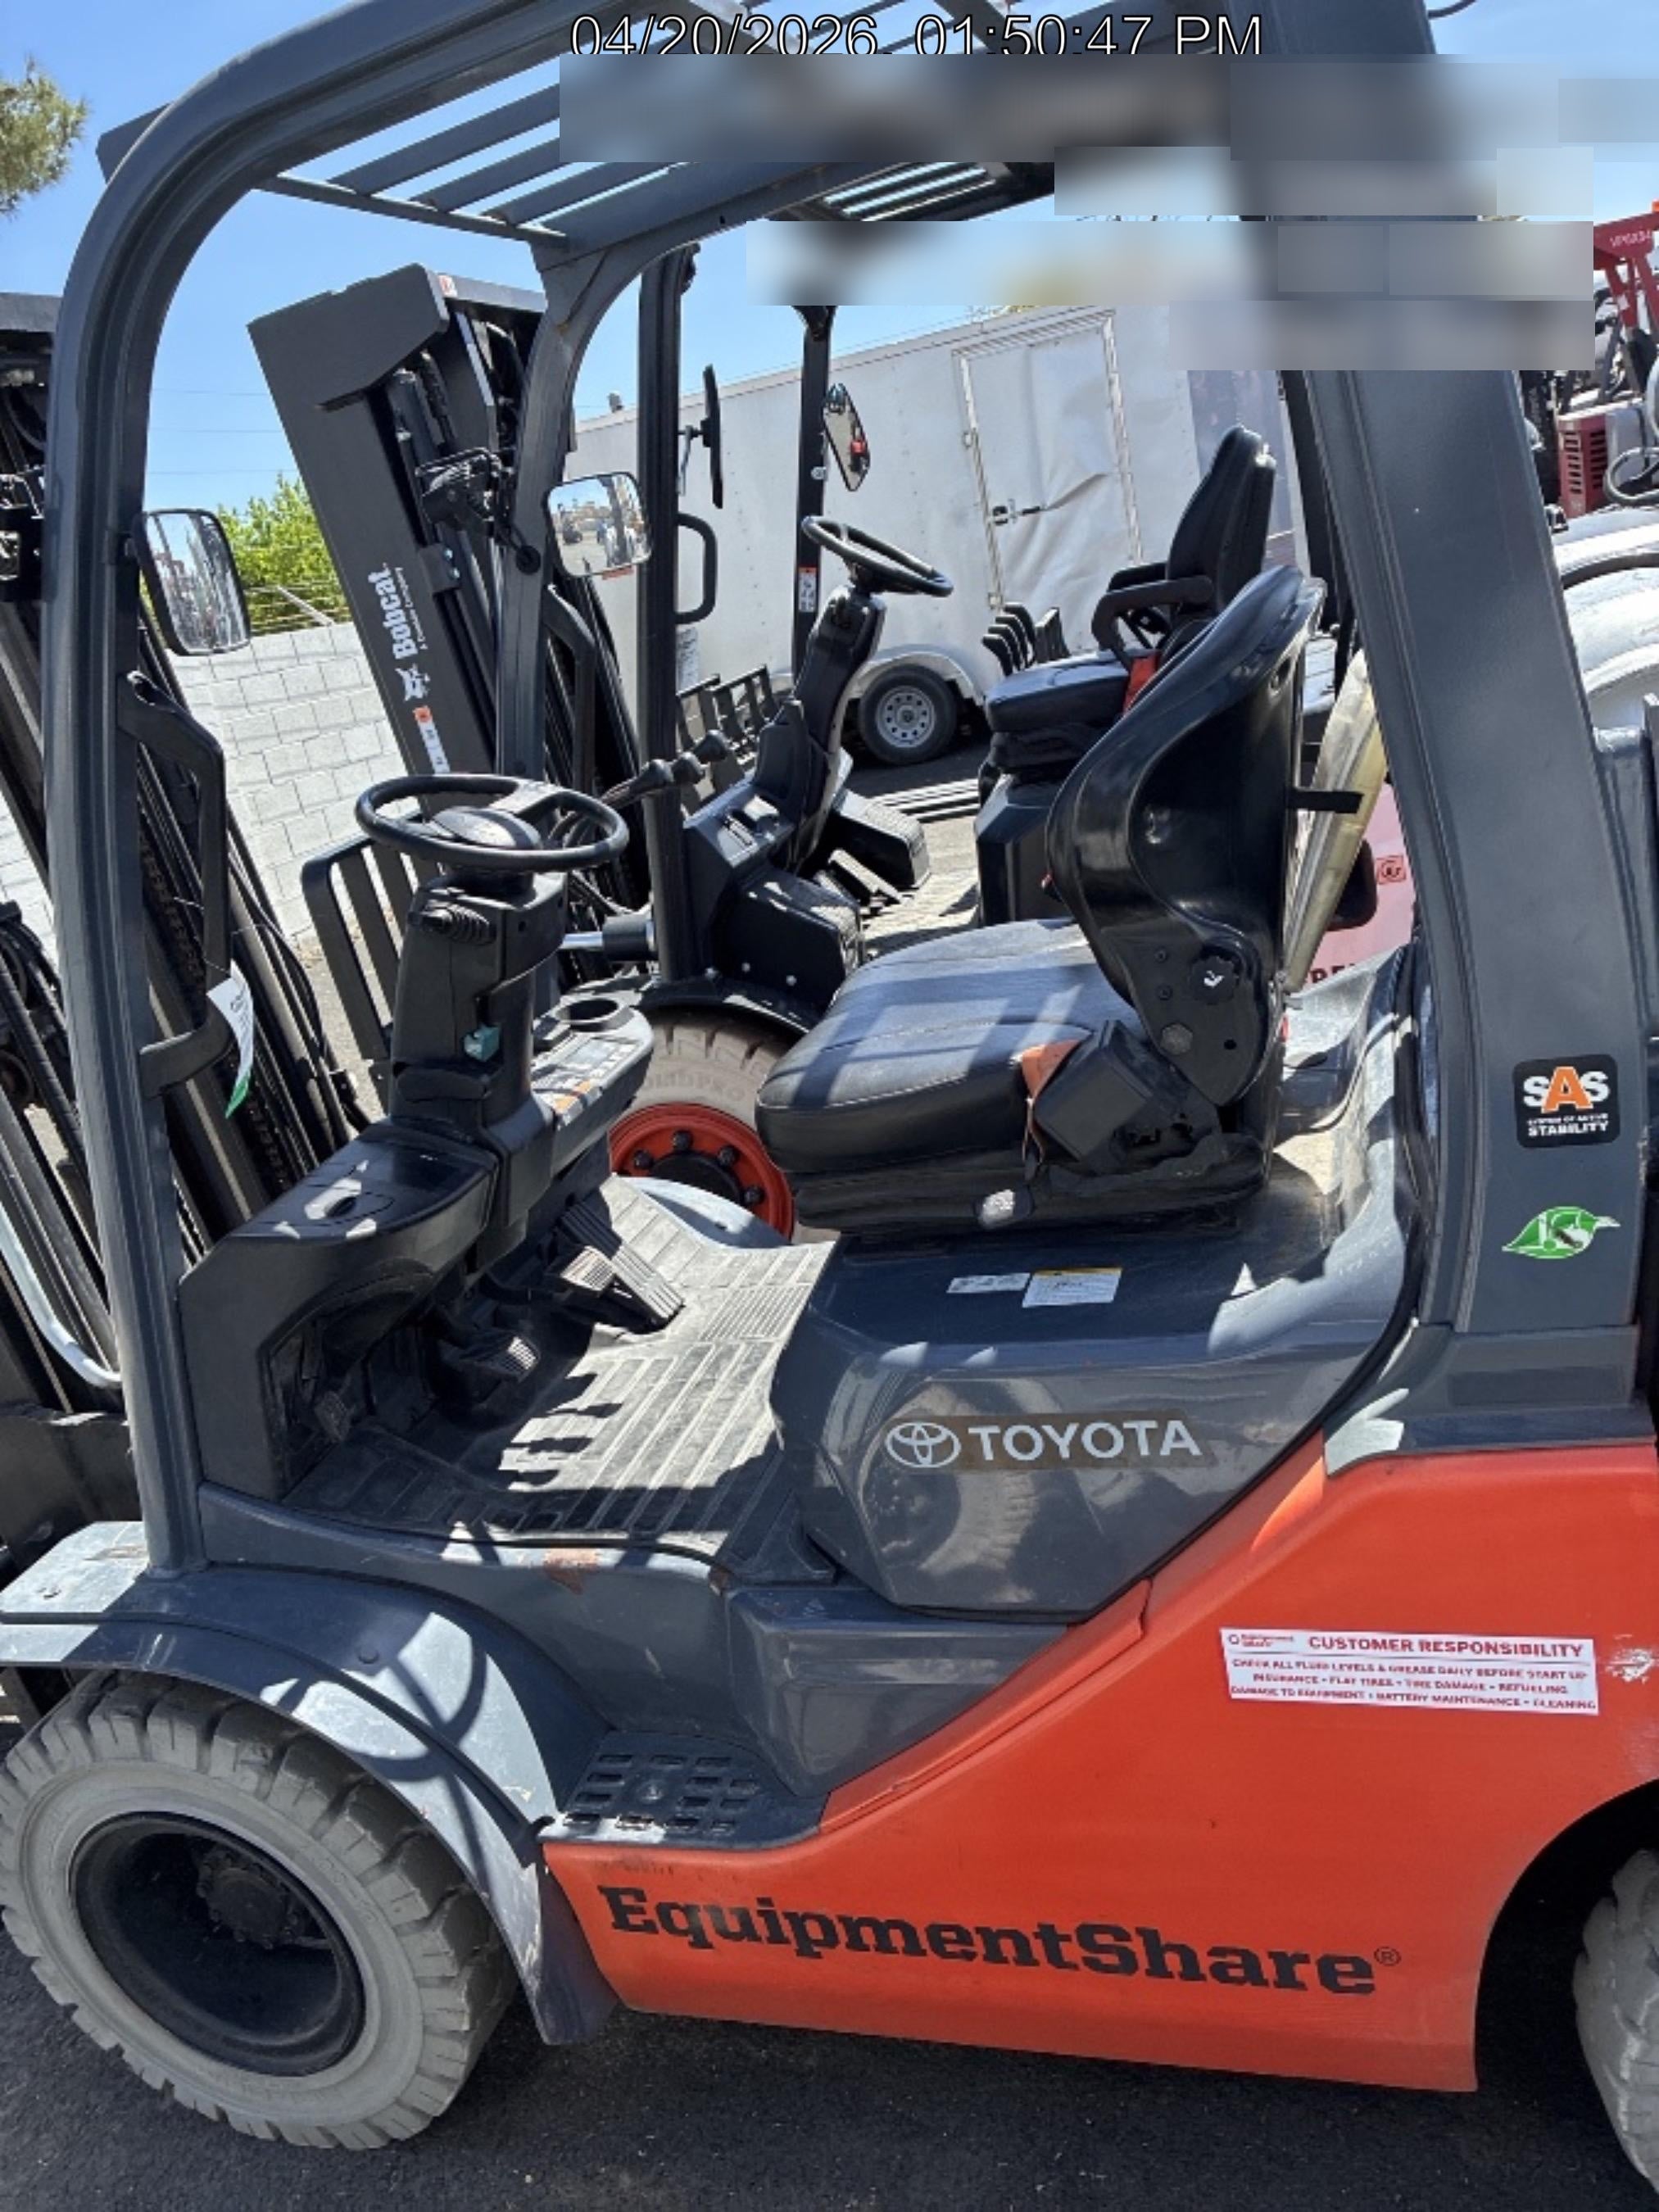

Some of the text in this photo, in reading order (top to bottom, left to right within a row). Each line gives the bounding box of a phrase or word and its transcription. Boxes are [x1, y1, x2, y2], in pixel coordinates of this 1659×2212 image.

[368, 567, 419, 660] Bobcat
[1523, 1065, 1611, 1113] SAS
[1528, 1121, 1609, 1137] STABILITY
[968, 1419, 1203, 1461] TOYOTA
[1309, 1636, 1415, 1651] CUSTOMER
[1419, 1640, 1584, 1657] RESPONSIBILITY
[1272, 1661, 1294, 1670] ALL
[1332, 1662, 1375, 1672] LEVELS
[1438, 1666, 1473, 1676] DAILY
[1476, 1668, 1522, 1678] BEFORE
[1526, 1670, 1566, 1679] START
[1253, 1673, 1320, 1684] INSURANCE
[1329, 1676, 1357, 1685] FLAT
[1361, 1677, 1394, 1687] TIRES
[1435, 1680, 1486, 1691] DAMAGE
[1498, 1683, 1569, 1694] REFUELING
[1281, 1688, 1296, 1697] TO
[1376, 1692, 1429, 1702] BATTERY
[1533, 1698, 1596, 1710] CLEANING
